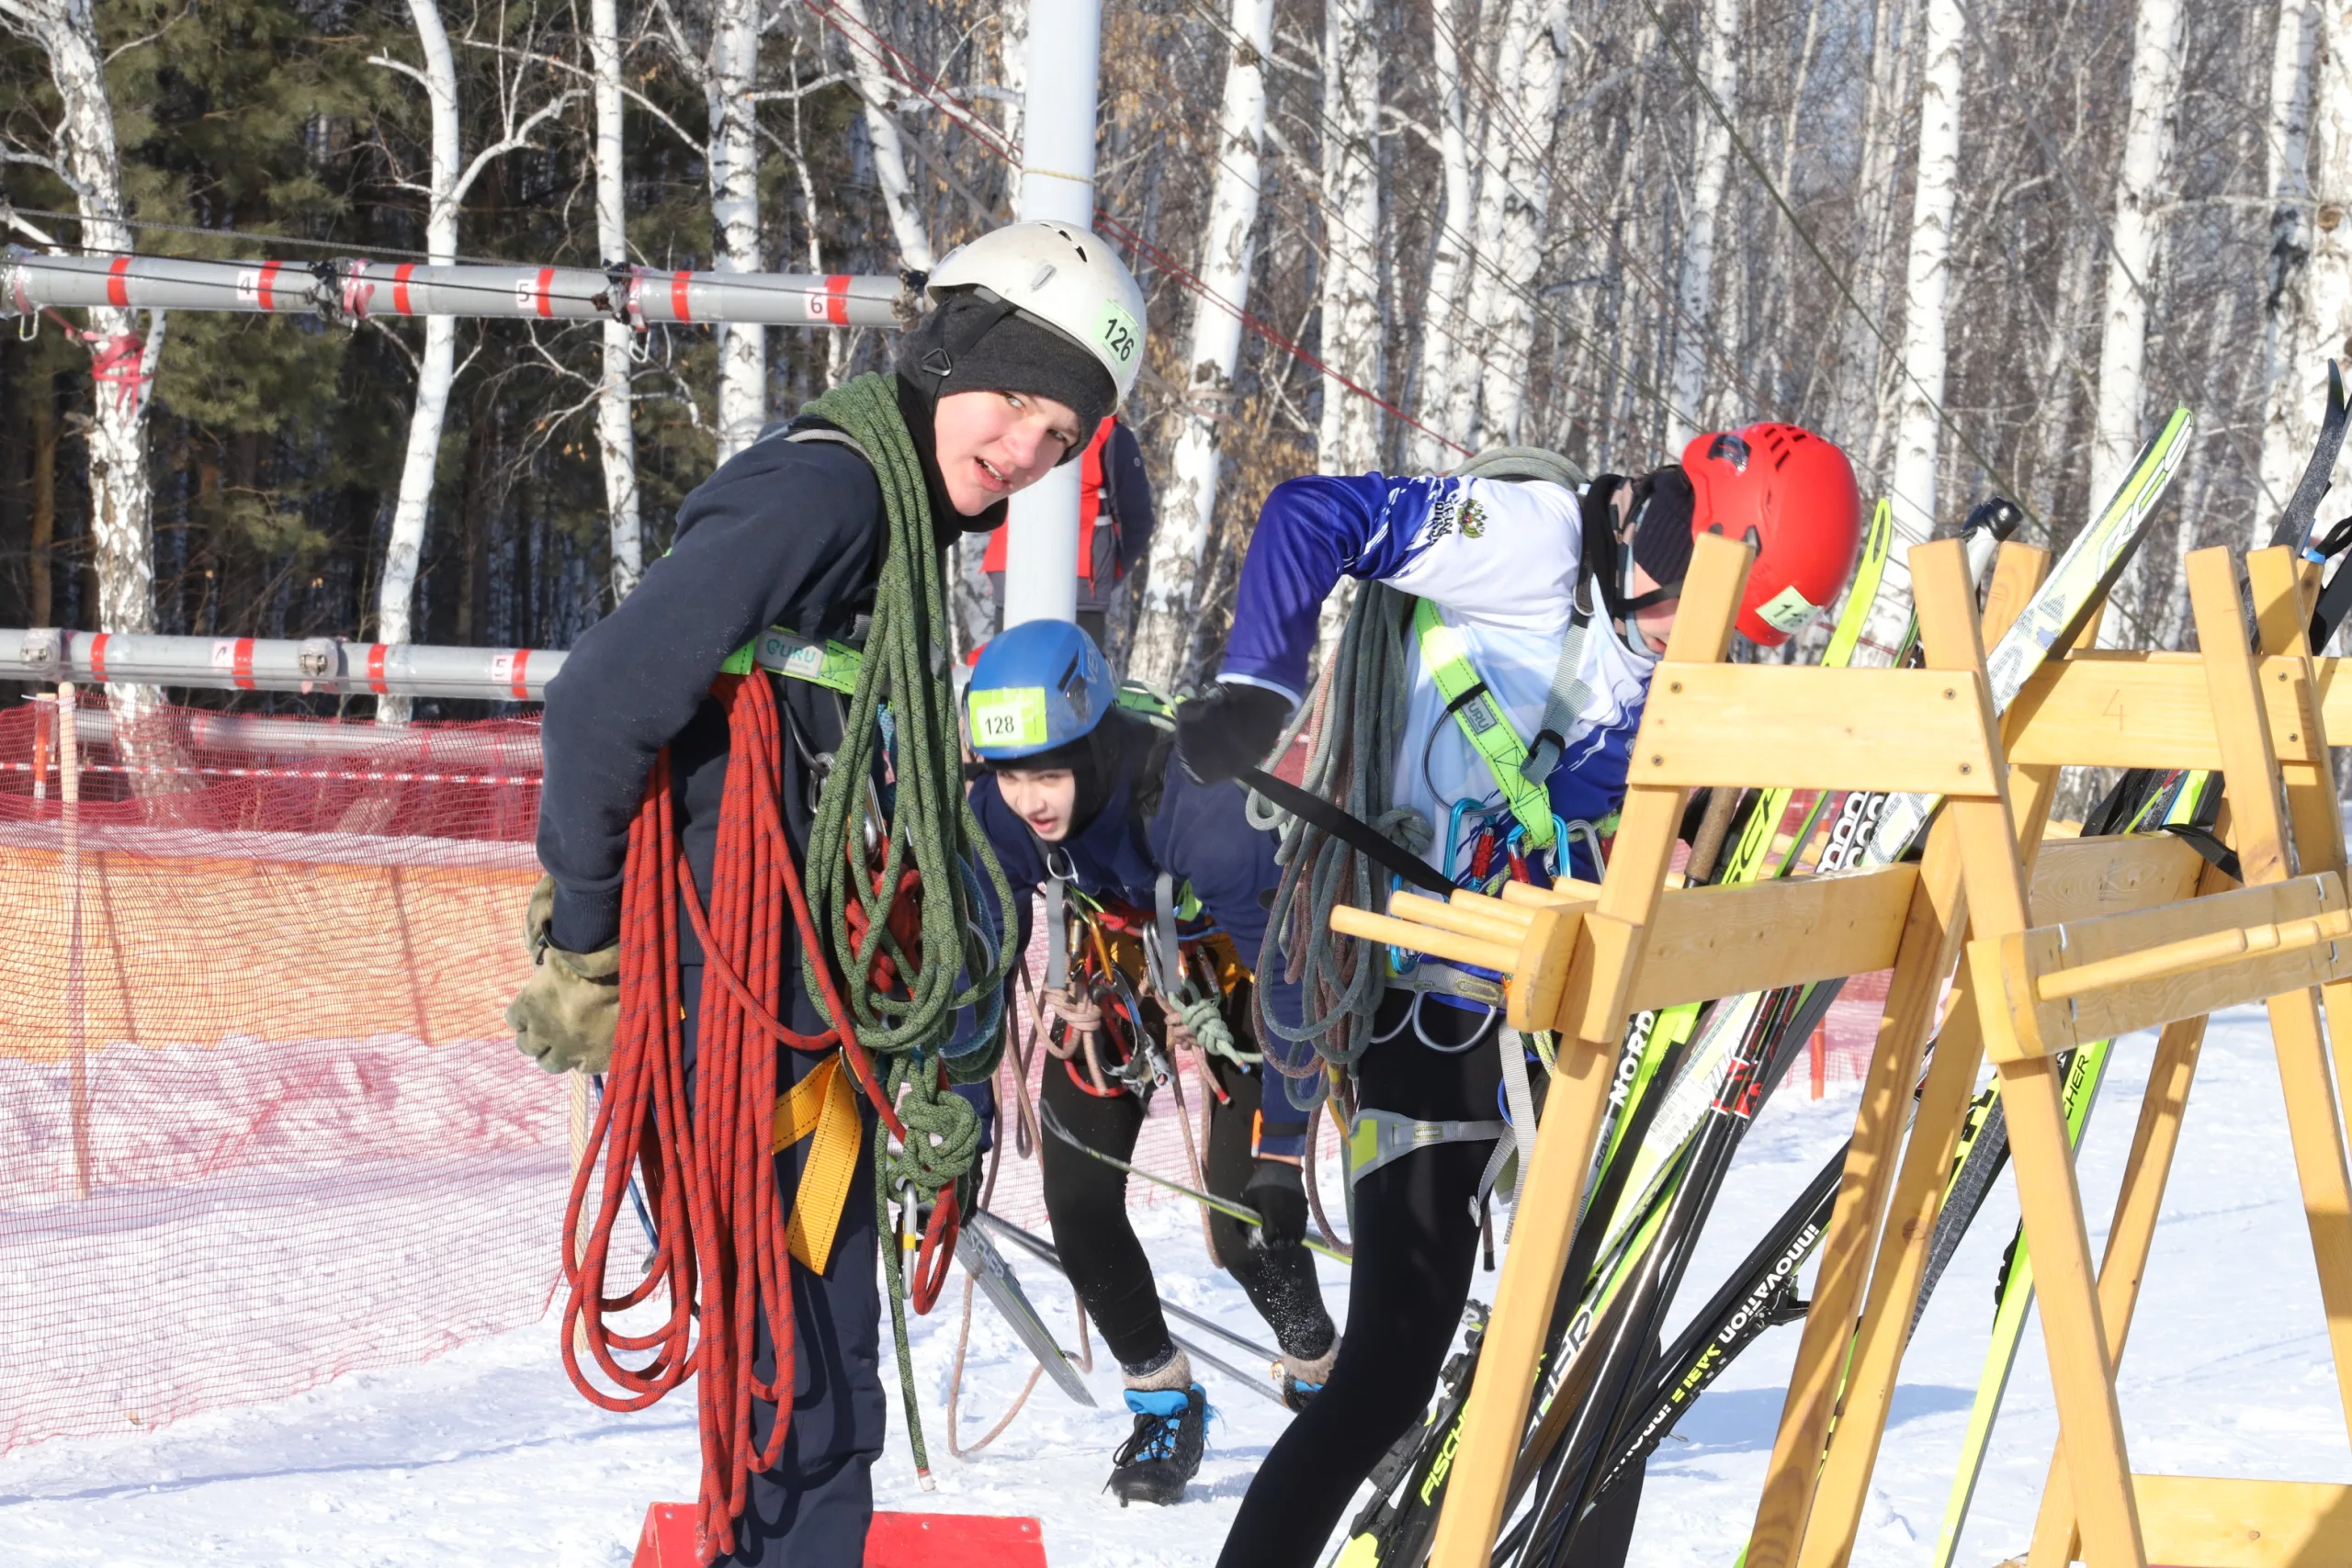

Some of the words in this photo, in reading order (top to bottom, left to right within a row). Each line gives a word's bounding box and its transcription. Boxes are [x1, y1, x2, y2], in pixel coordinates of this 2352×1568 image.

[239, 276, 251, 296] 4
[518, 282, 530, 303] 5
[809, 292, 823, 314] 6
[1104, 318, 1135, 362] 126
[1467, 700, 1490, 729] URU
[2102, 688, 2129, 733] 4
[984, 716, 1014, 736] 128
